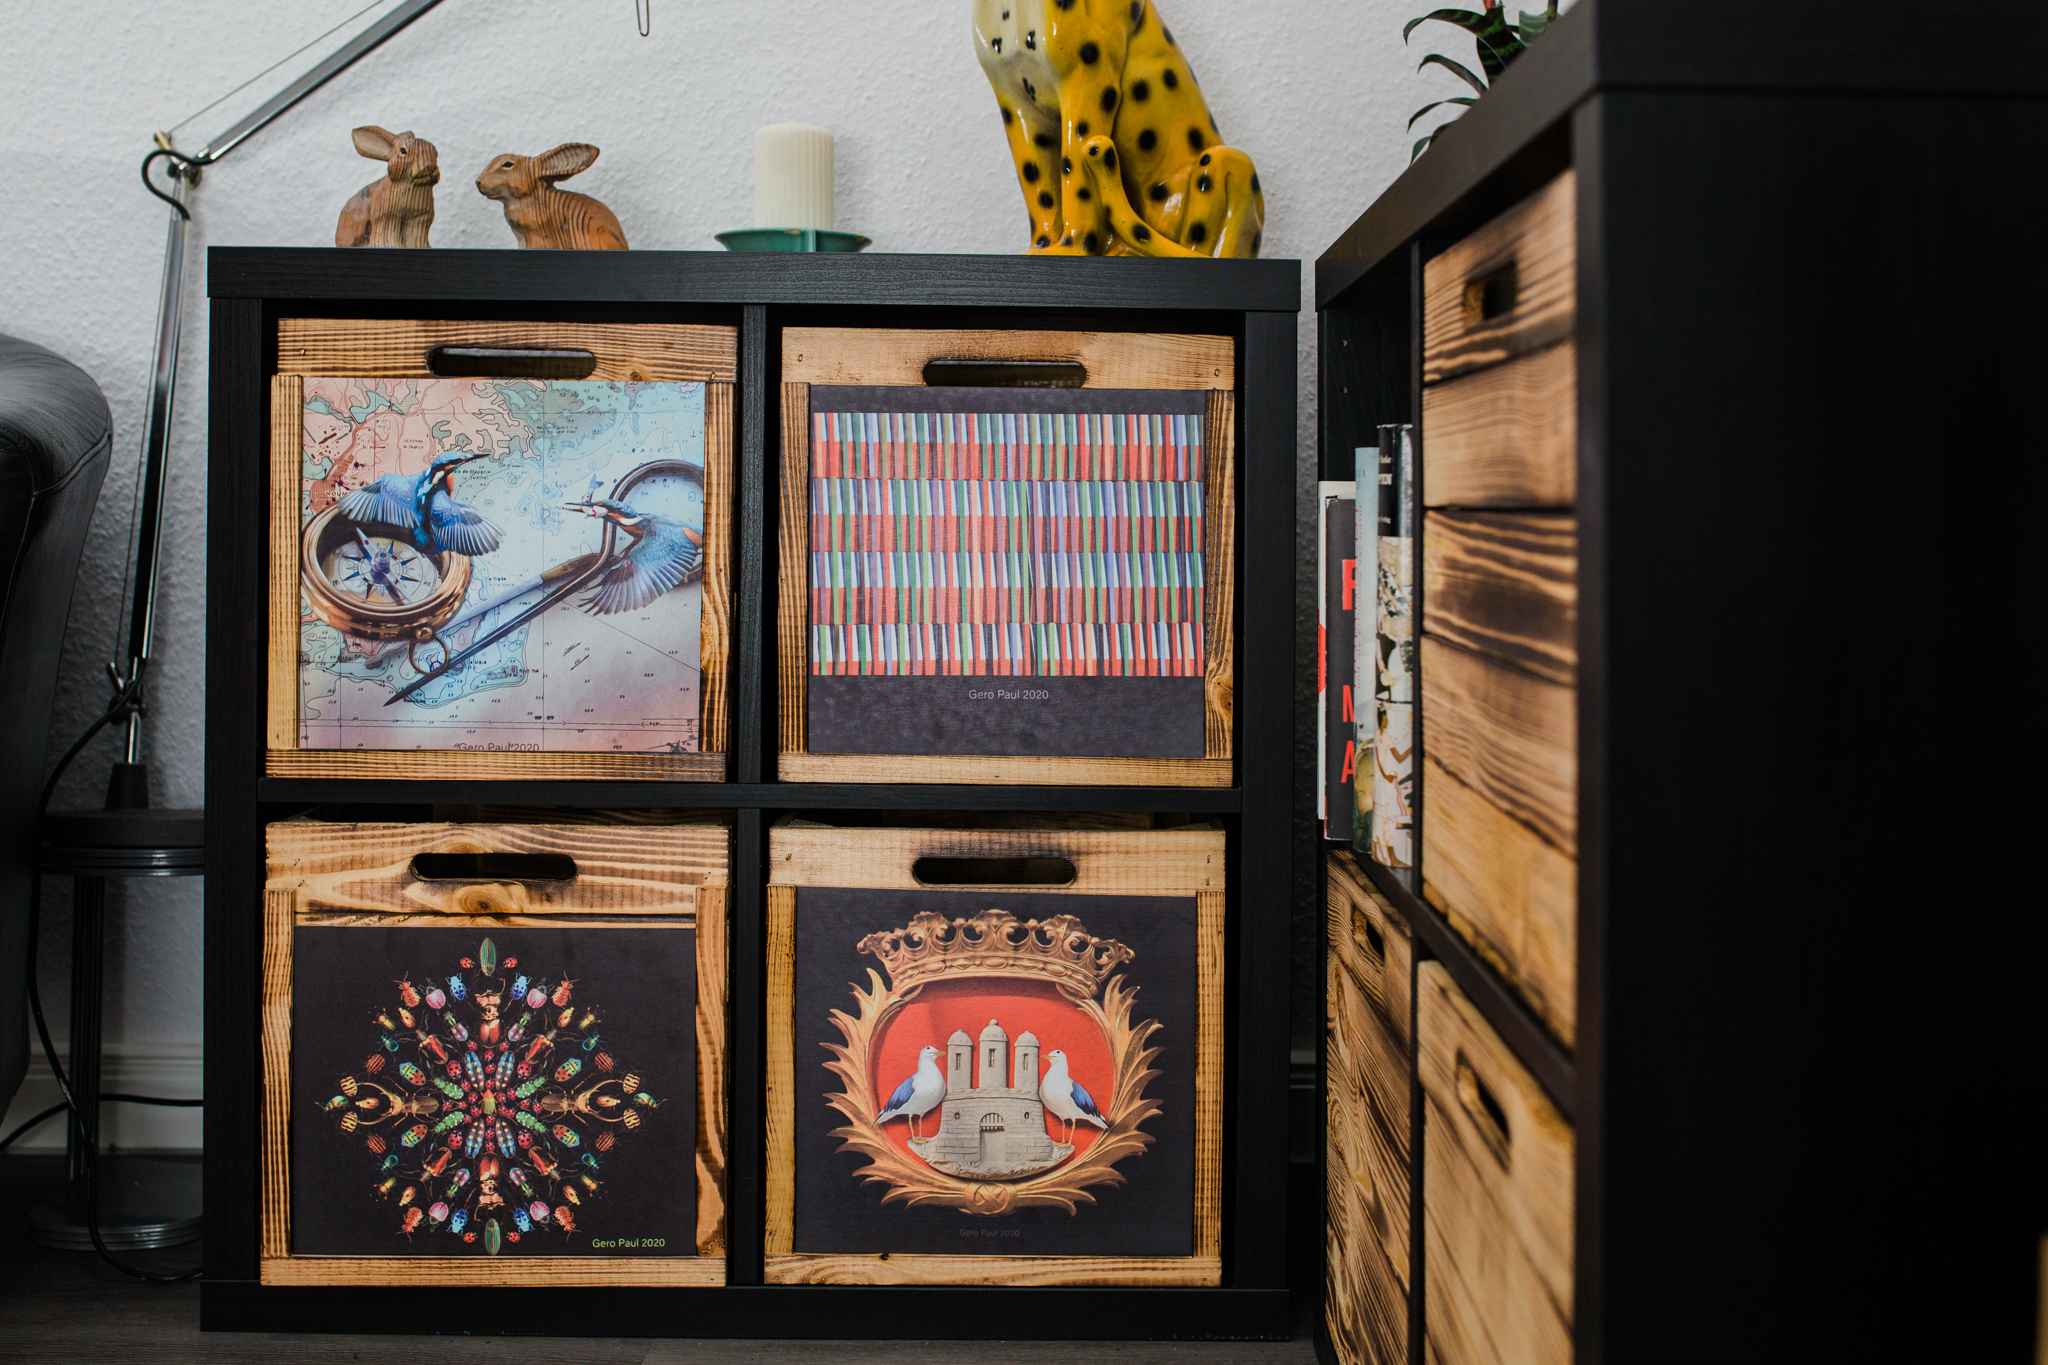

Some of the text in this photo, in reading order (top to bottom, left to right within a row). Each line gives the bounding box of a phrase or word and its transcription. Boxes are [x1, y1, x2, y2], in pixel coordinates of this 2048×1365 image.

[968, 689, 1049, 700] Gero Paul 2020
[959, 1228, 1020, 1237] Gero Paul 2020
[592, 1237, 666, 1248] Gero Paul 2020
